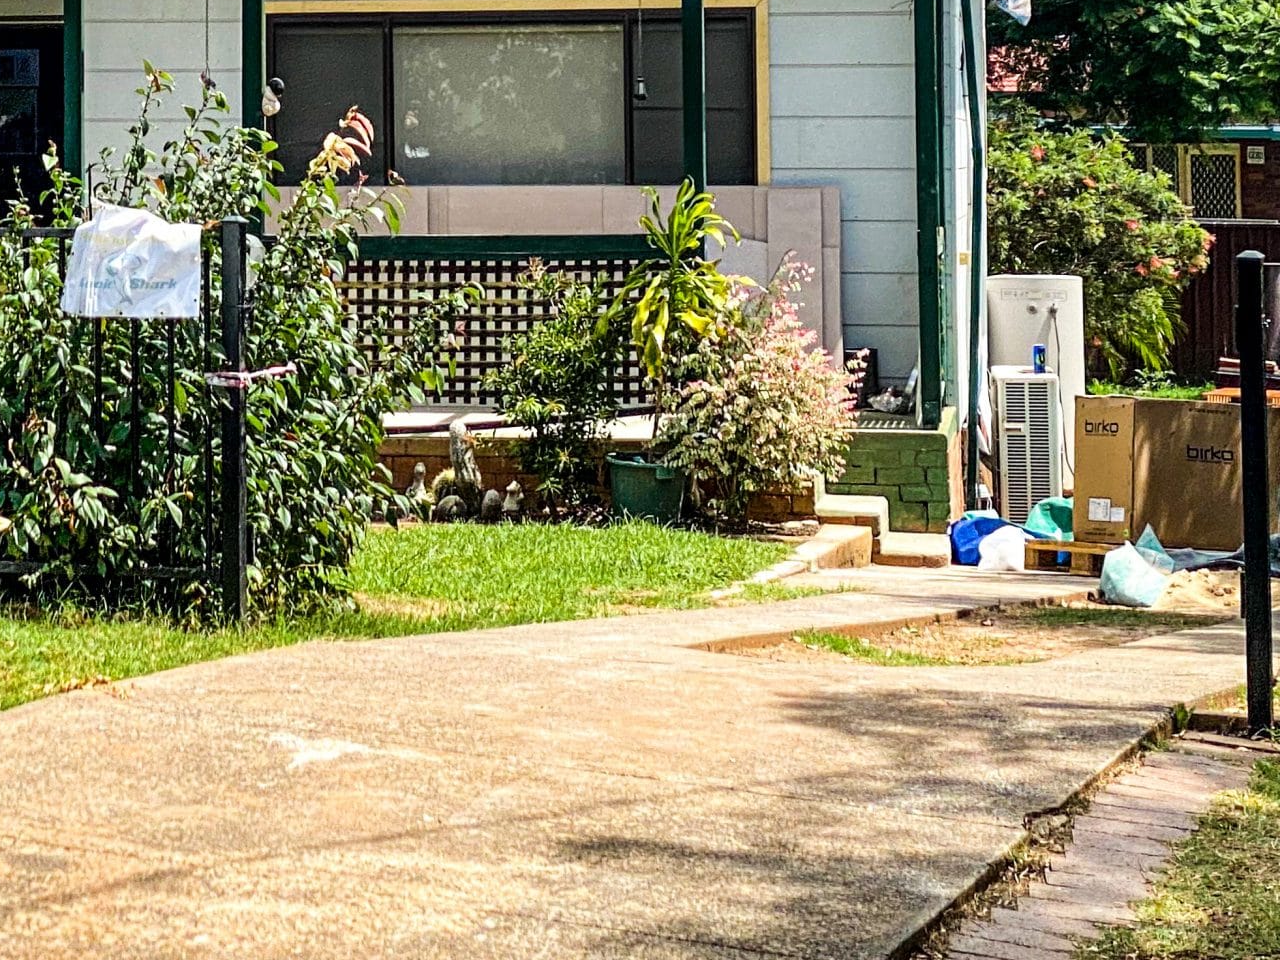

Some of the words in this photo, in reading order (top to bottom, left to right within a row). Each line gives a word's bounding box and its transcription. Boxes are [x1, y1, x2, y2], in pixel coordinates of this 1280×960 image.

[129, 278, 177, 290] Shark
[1085, 419, 1119, 433] birko
[1186, 445, 1234, 461] birko
